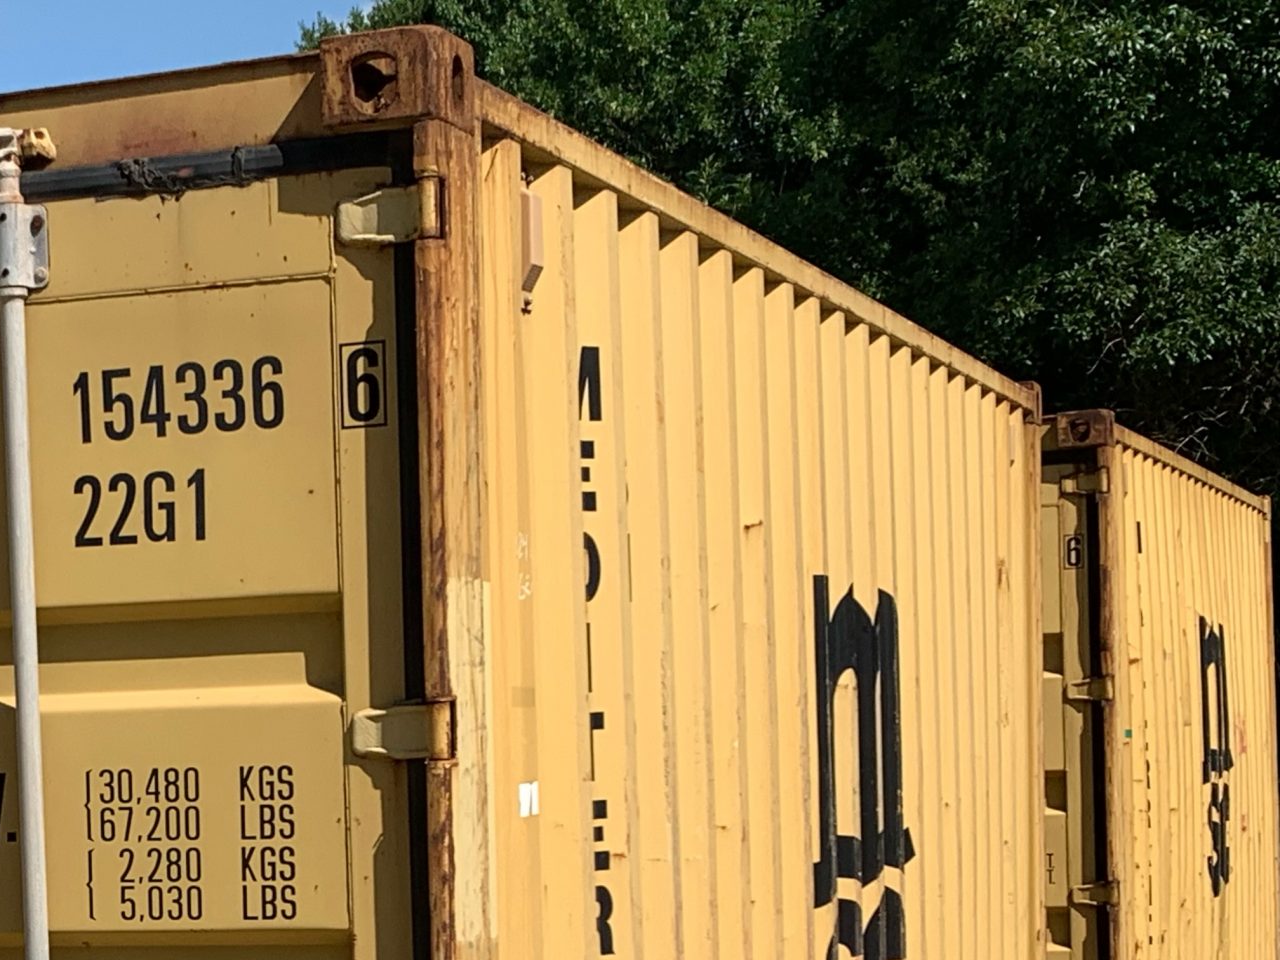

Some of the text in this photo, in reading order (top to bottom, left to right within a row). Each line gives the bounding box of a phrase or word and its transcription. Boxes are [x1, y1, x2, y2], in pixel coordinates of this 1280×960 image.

[72, 356, 285, 443] 154336
[346, 346, 382, 423] 6
[73, 468, 206, 547] 22G1
[1066, 536, 1081, 567] 6
[99, 767, 200, 804] 30,480
[238, 765, 294, 801] KGS
[99, 805, 295, 842] 67,200 LBS
[119, 847, 201, 884] 2,280
[240, 846, 296, 882] KGS
[120, 885, 297, 922] 5,030 LBS
